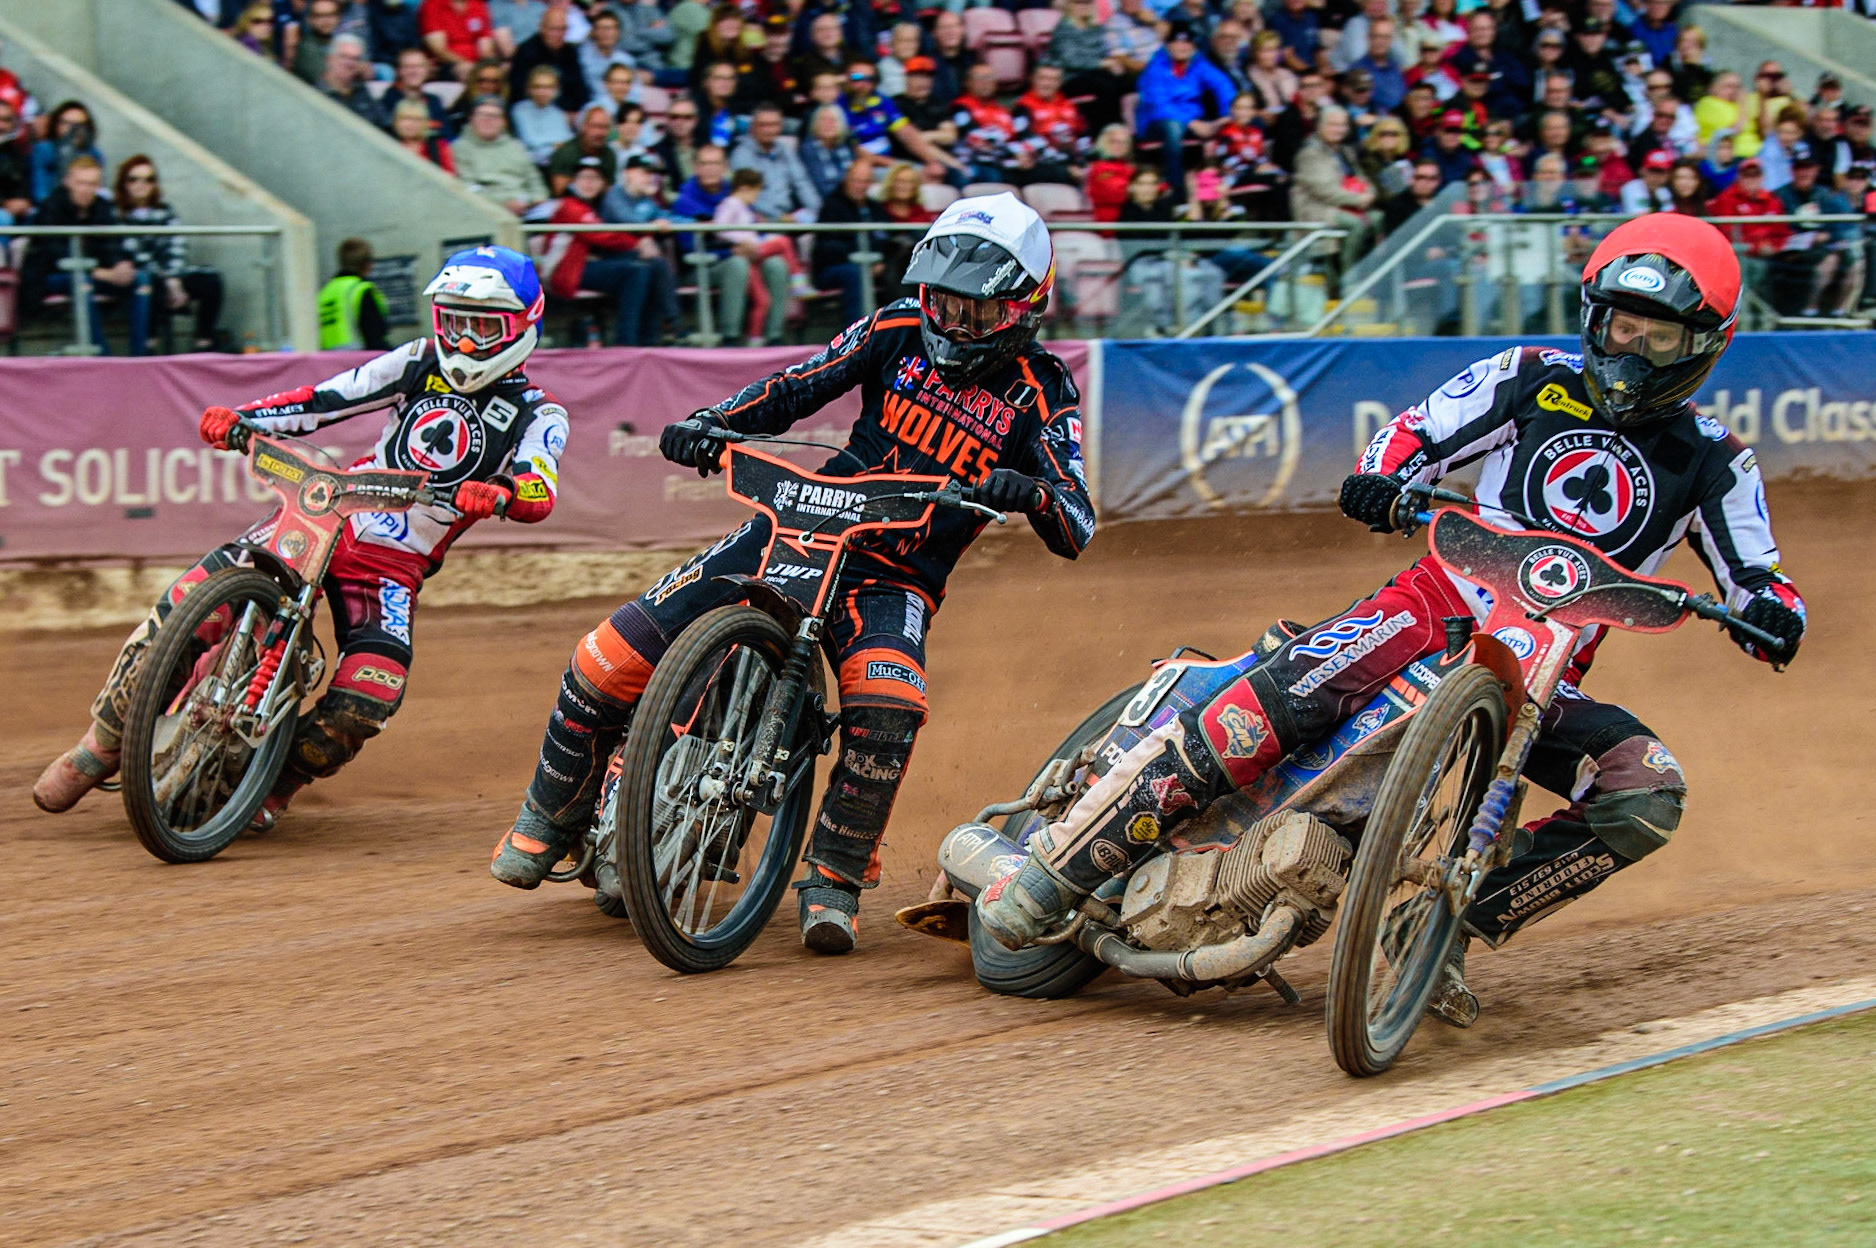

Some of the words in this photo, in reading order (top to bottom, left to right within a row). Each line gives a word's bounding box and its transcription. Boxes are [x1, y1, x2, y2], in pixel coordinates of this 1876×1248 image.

[1543, 388, 1590, 418] Rentruck
[1771, 387, 1876, 446] Clas
[415, 398, 450, 416] BELLE
[453, 398, 472, 420] VUE
[469, 422, 483, 454] ACES
[879, 389, 999, 487] WOLVES
[1543, 435, 1593, 461] BELLE
[1629, 465, 1649, 508] ACES
[798, 483, 867, 513] PARRYS
[764, 575, 789, 586] racing
[765, 562, 823, 580] JWP
[1527, 548, 1555, 564] BELLE
[1557, 549, 1575, 561] VUE
[1575, 559, 1588, 581] ACES
[653, 564, 704, 606] racing
[1292, 611, 1416, 696] WESSEXMARINE
[1501, 635, 1527, 652] ATPI
[870, 663, 927, 697] Muc-Off
[1513, 856, 1594, 907] FLOORING
